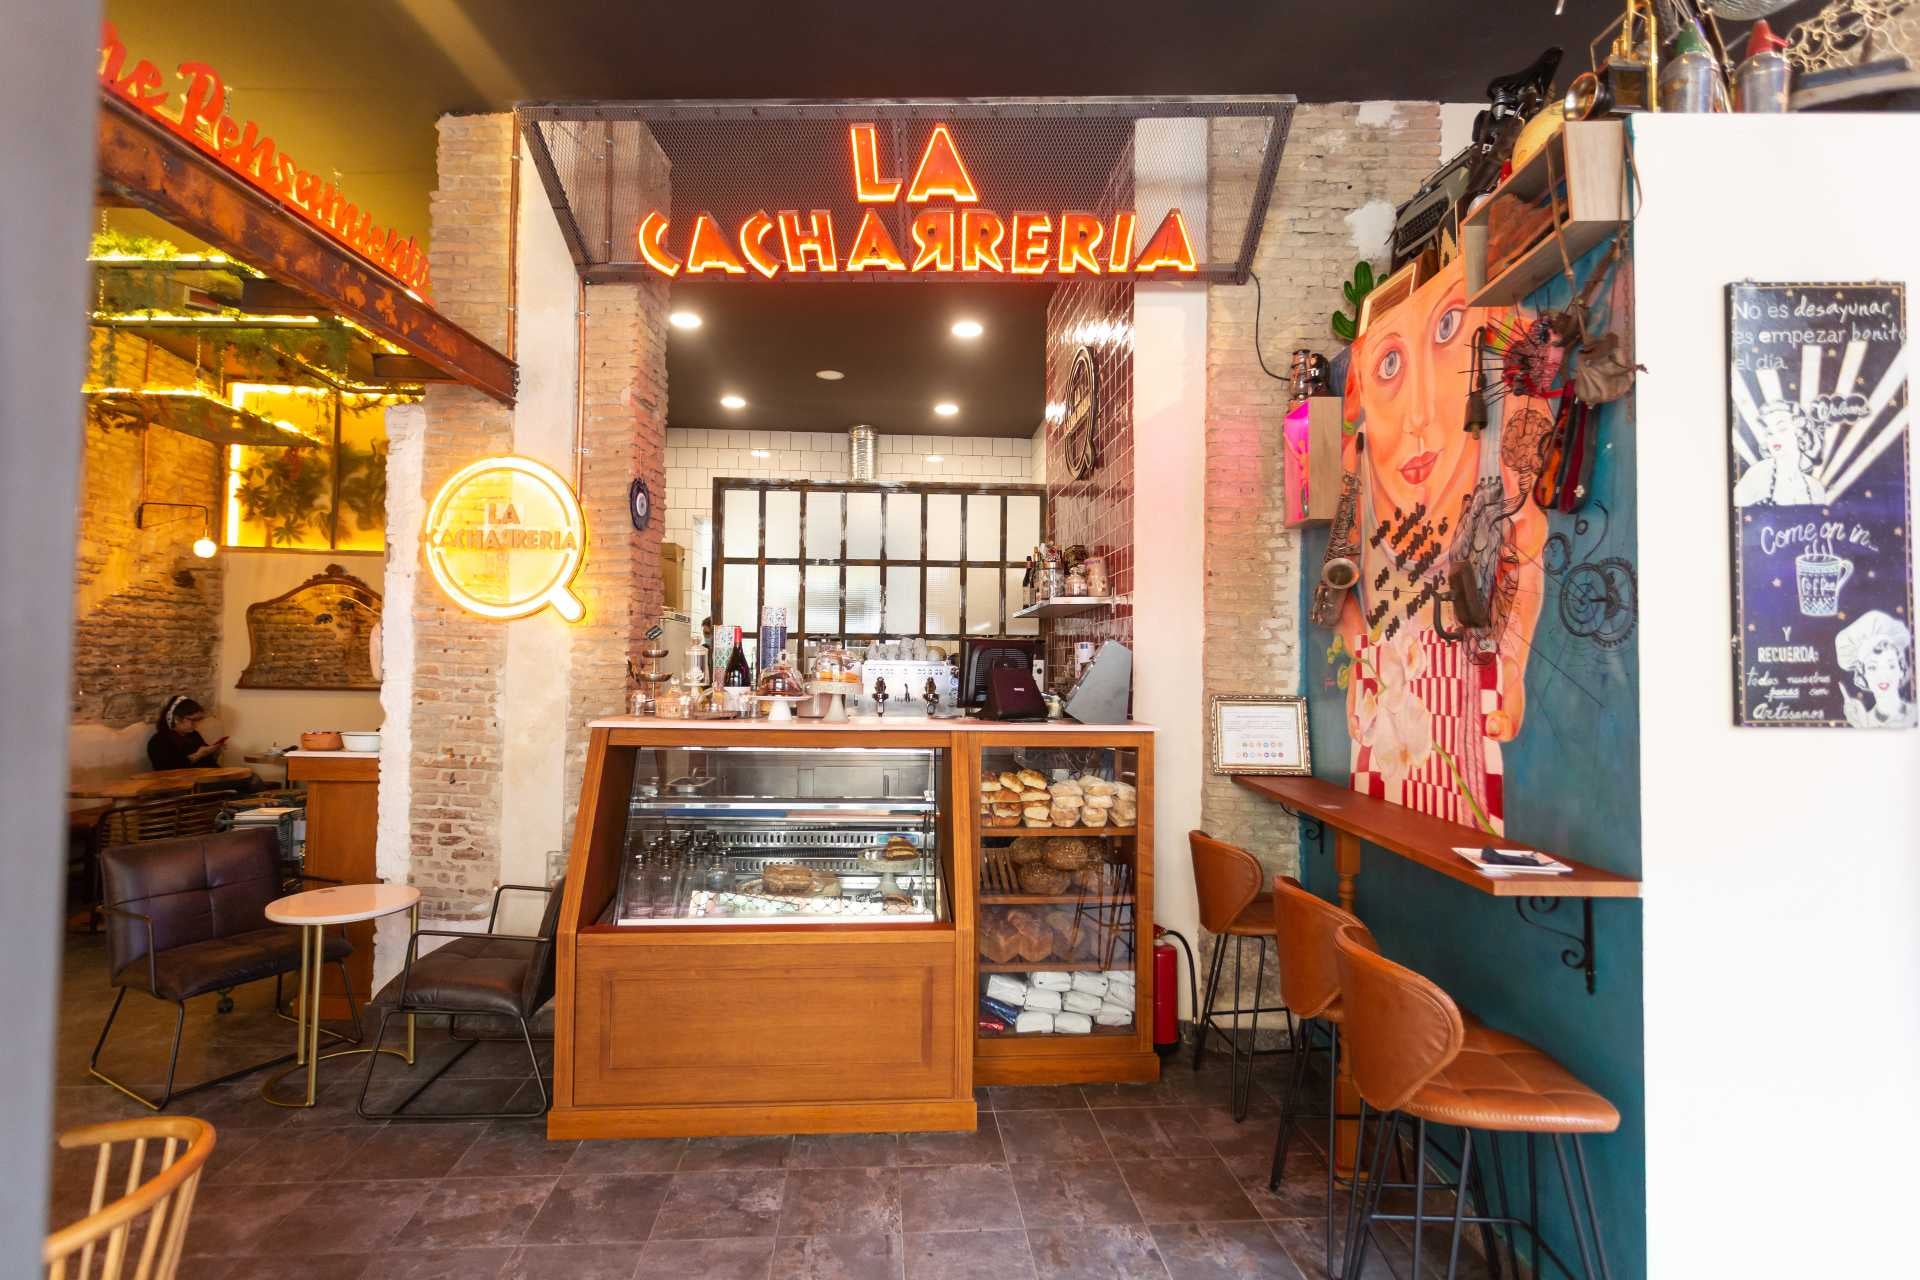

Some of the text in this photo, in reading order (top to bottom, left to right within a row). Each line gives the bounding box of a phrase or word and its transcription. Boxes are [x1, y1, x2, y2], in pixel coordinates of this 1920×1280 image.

[848, 122, 978, 202] LA
[637, 207, 1198, 278] CACHARRERIA
[1732, 301, 1761, 320] No
[1767, 304, 1789, 318] es
[1733, 322, 1905, 348] es empezar bonito
[1735, 355, 1751, 370] el
[488, 503, 520, 525] LA
[1760, 522, 1817, 555] Come
[1820, 521, 1846, 541] on
[1782, 626, 1792, 642] Y
